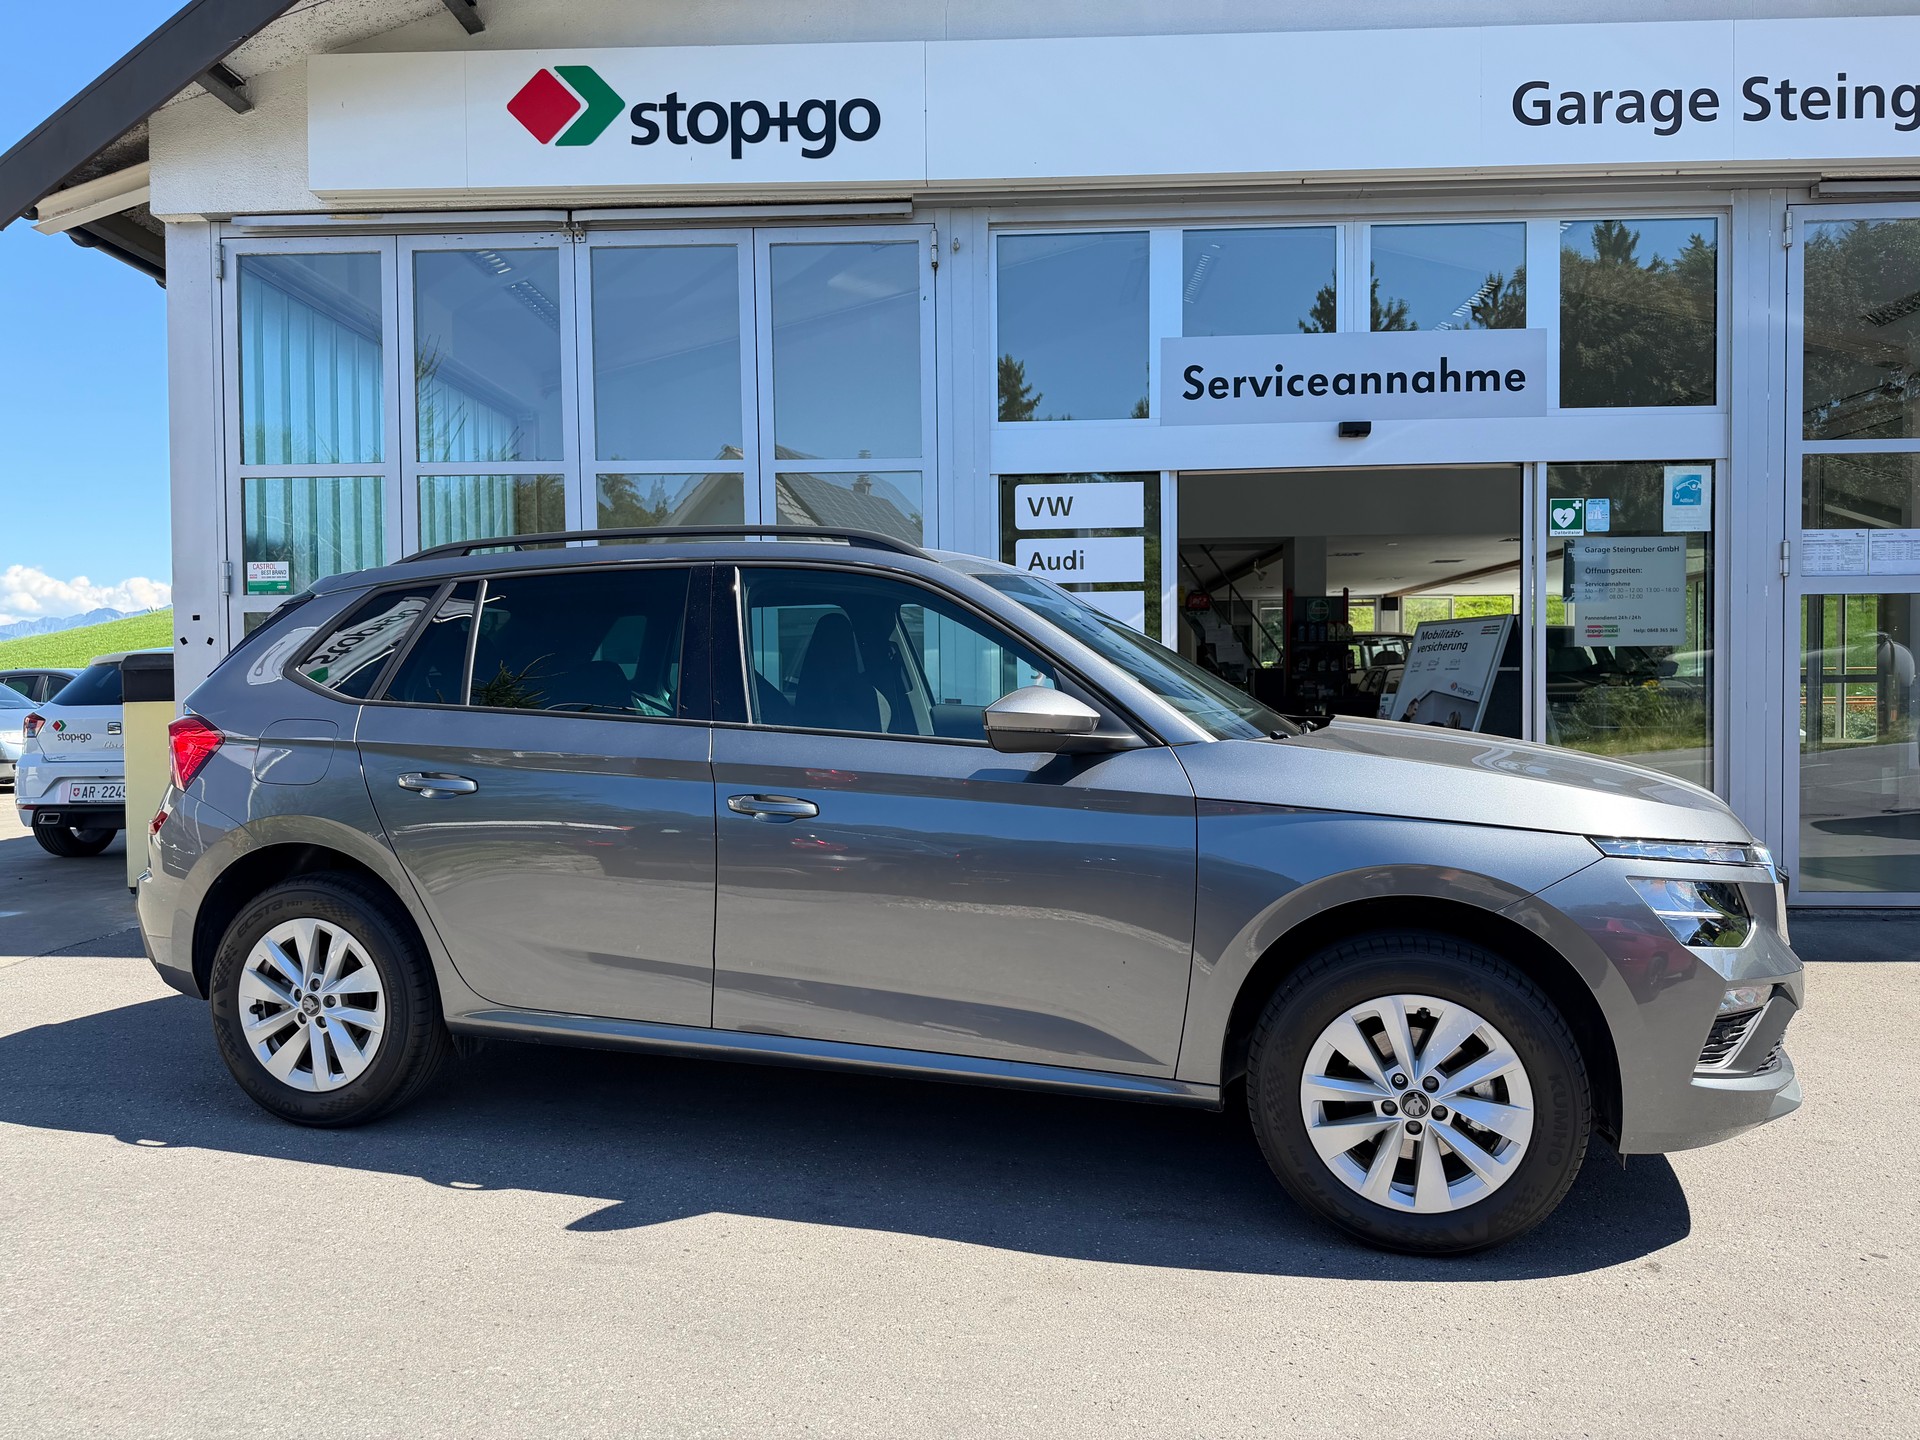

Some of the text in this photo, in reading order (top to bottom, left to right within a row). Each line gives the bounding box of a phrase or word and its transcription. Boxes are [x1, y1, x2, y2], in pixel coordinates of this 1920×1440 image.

[1512, 80, 1720, 136] Garage
[630, 91, 881, 160] stop+go
[1182, 356, 1526, 401] Serviceannahme
[1027, 496, 1074, 517] VW
[1585, 547, 1611, 555] Garage
[1612, 546, 1655, 554] Steingruber
[1027, 550, 1085, 571] Audi
[1585, 566, 1643, 575] Öffnungszeiten:
[1421, 629, 1465, 641] Mobilitäts-
[1417, 642, 1468, 653] versicherung
[57, 733, 92, 743] stop+go
